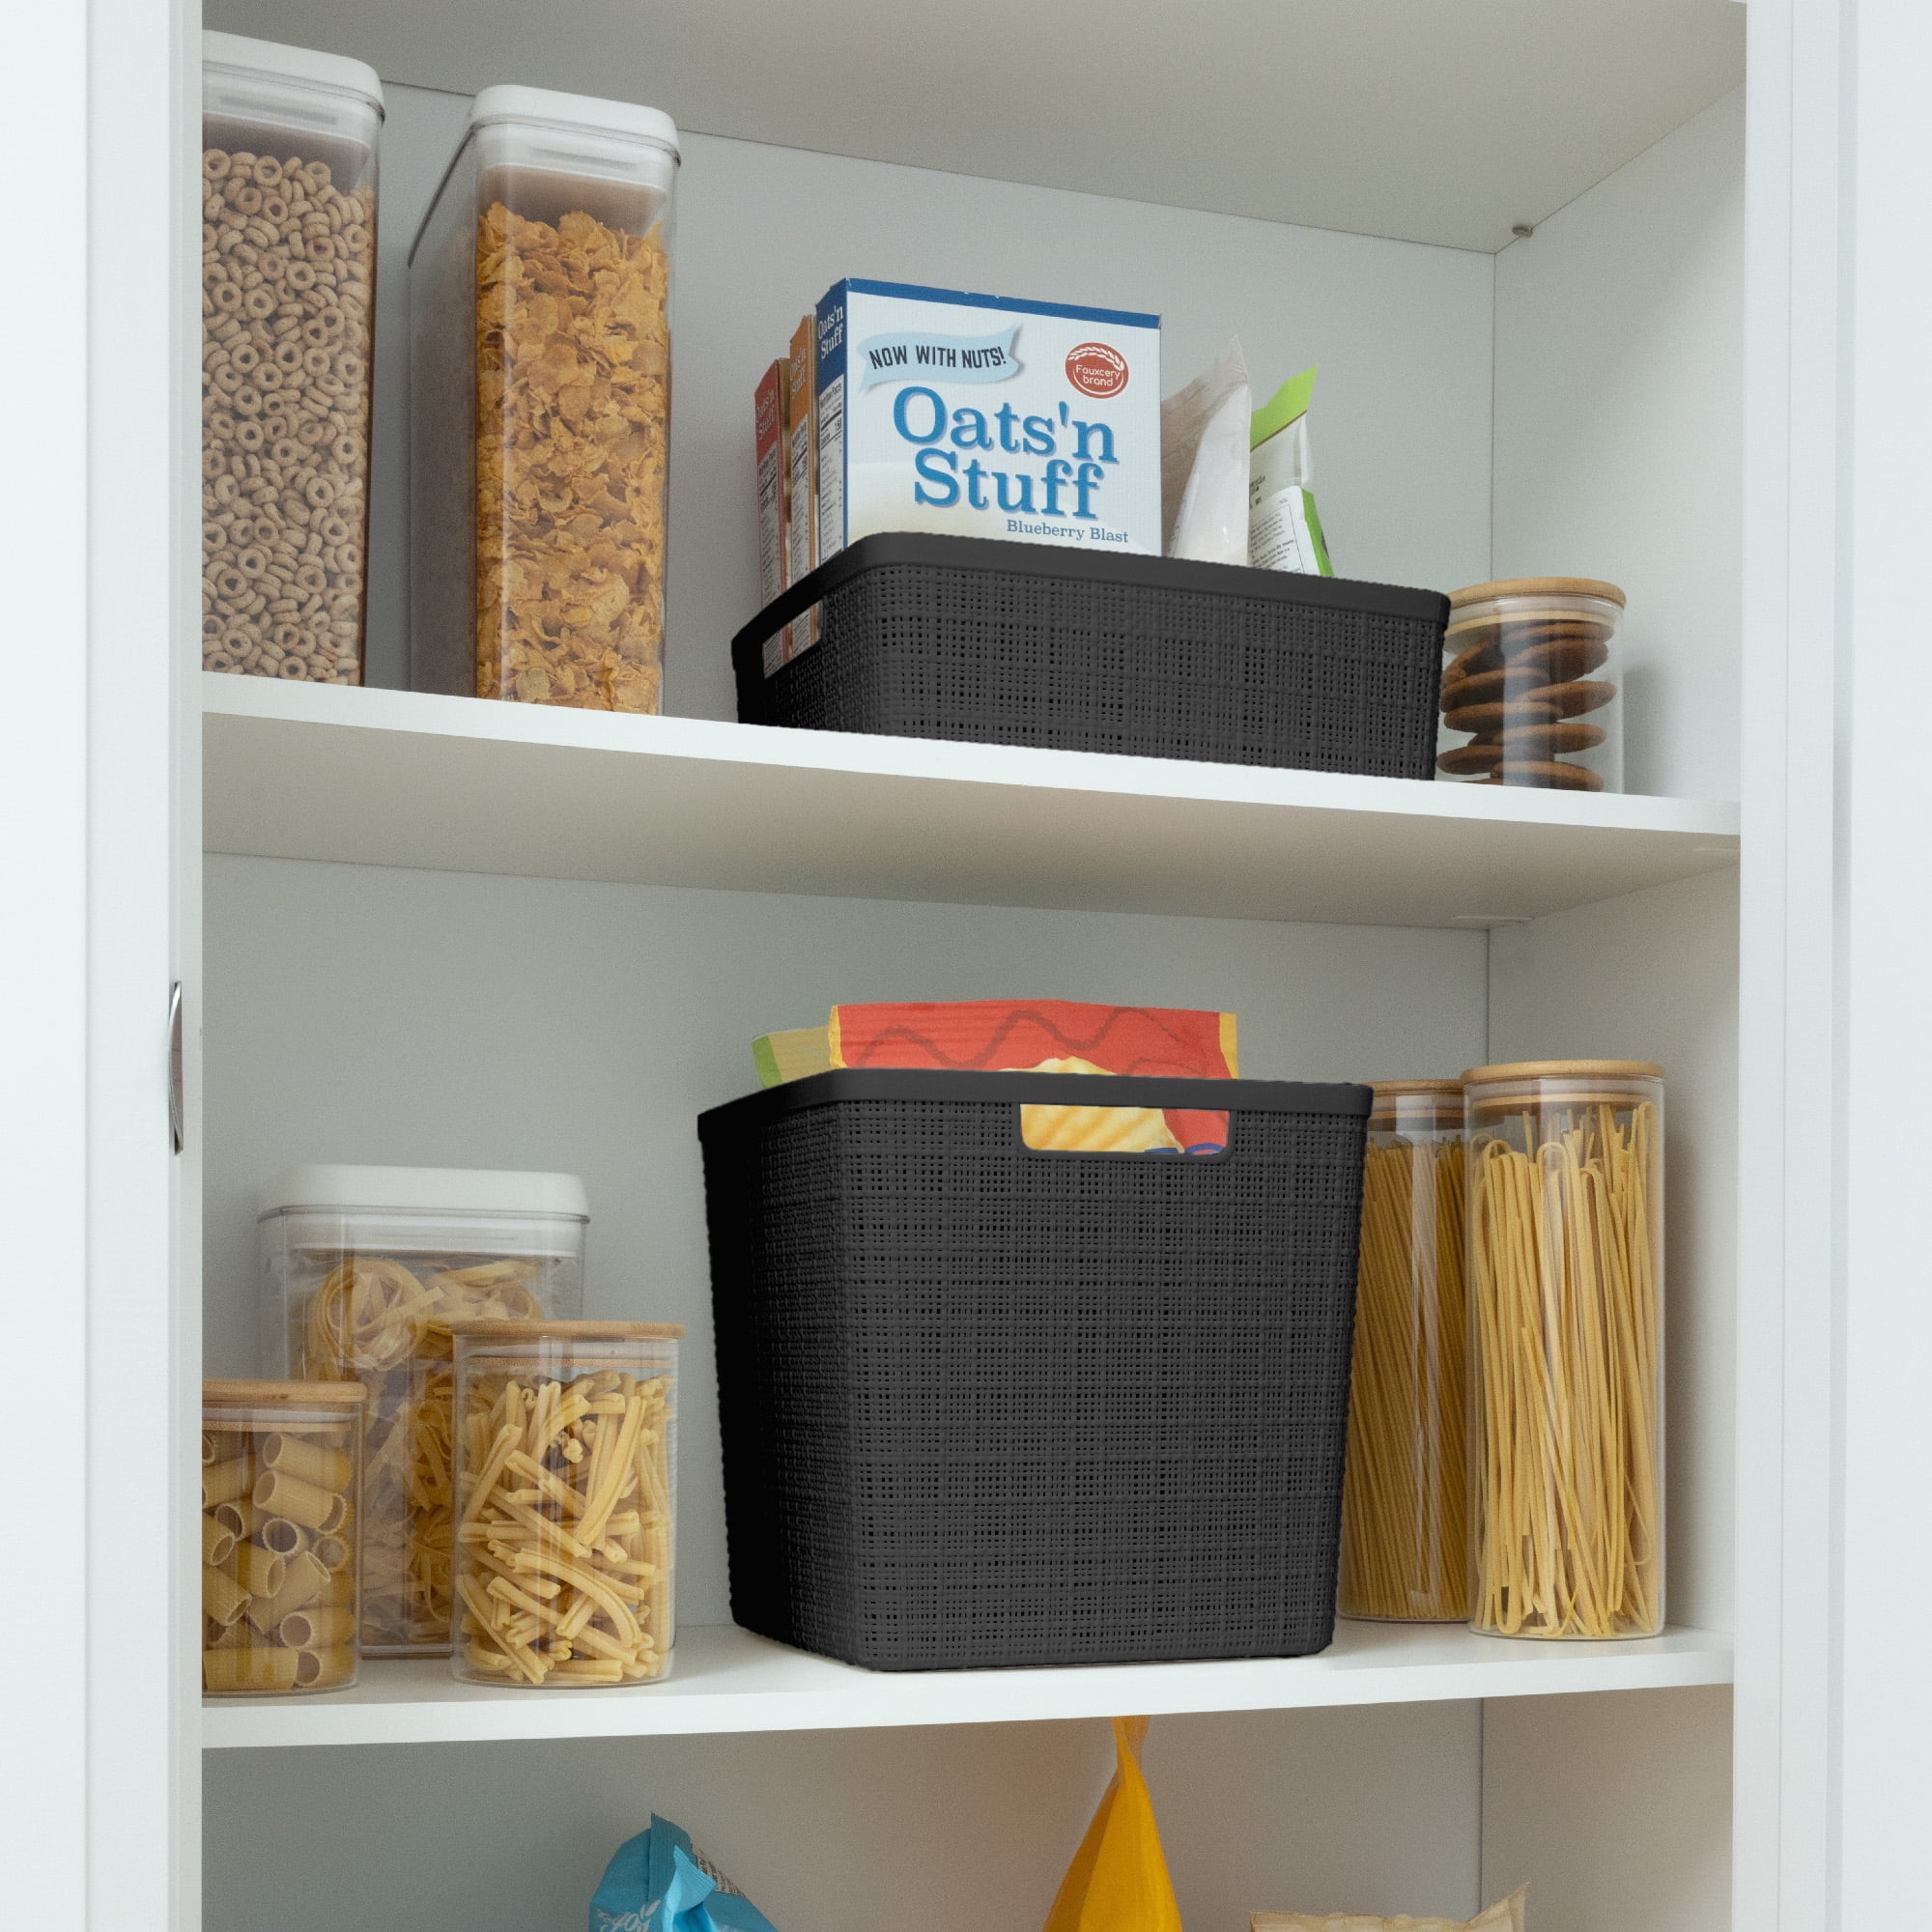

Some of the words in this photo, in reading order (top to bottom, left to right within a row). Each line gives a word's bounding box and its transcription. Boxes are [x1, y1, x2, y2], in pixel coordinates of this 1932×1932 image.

[818, 304, 843, 340] Oats'n
[821, 323, 843, 359] Stuff
[868, 345, 908, 370] NOW
[916, 345, 956, 368] WITH
[961, 346, 1007, 369] NUTS!
[1075, 363, 1121, 381] Fauxcery
[1082, 374, 1114, 386] brand
[894, 385, 1119, 464] Oats'n
[914, 447, 1103, 521] Stuff
[1007, 519, 1085, 541] Blueberry
[1090, 526, 1128, 543] Blast
